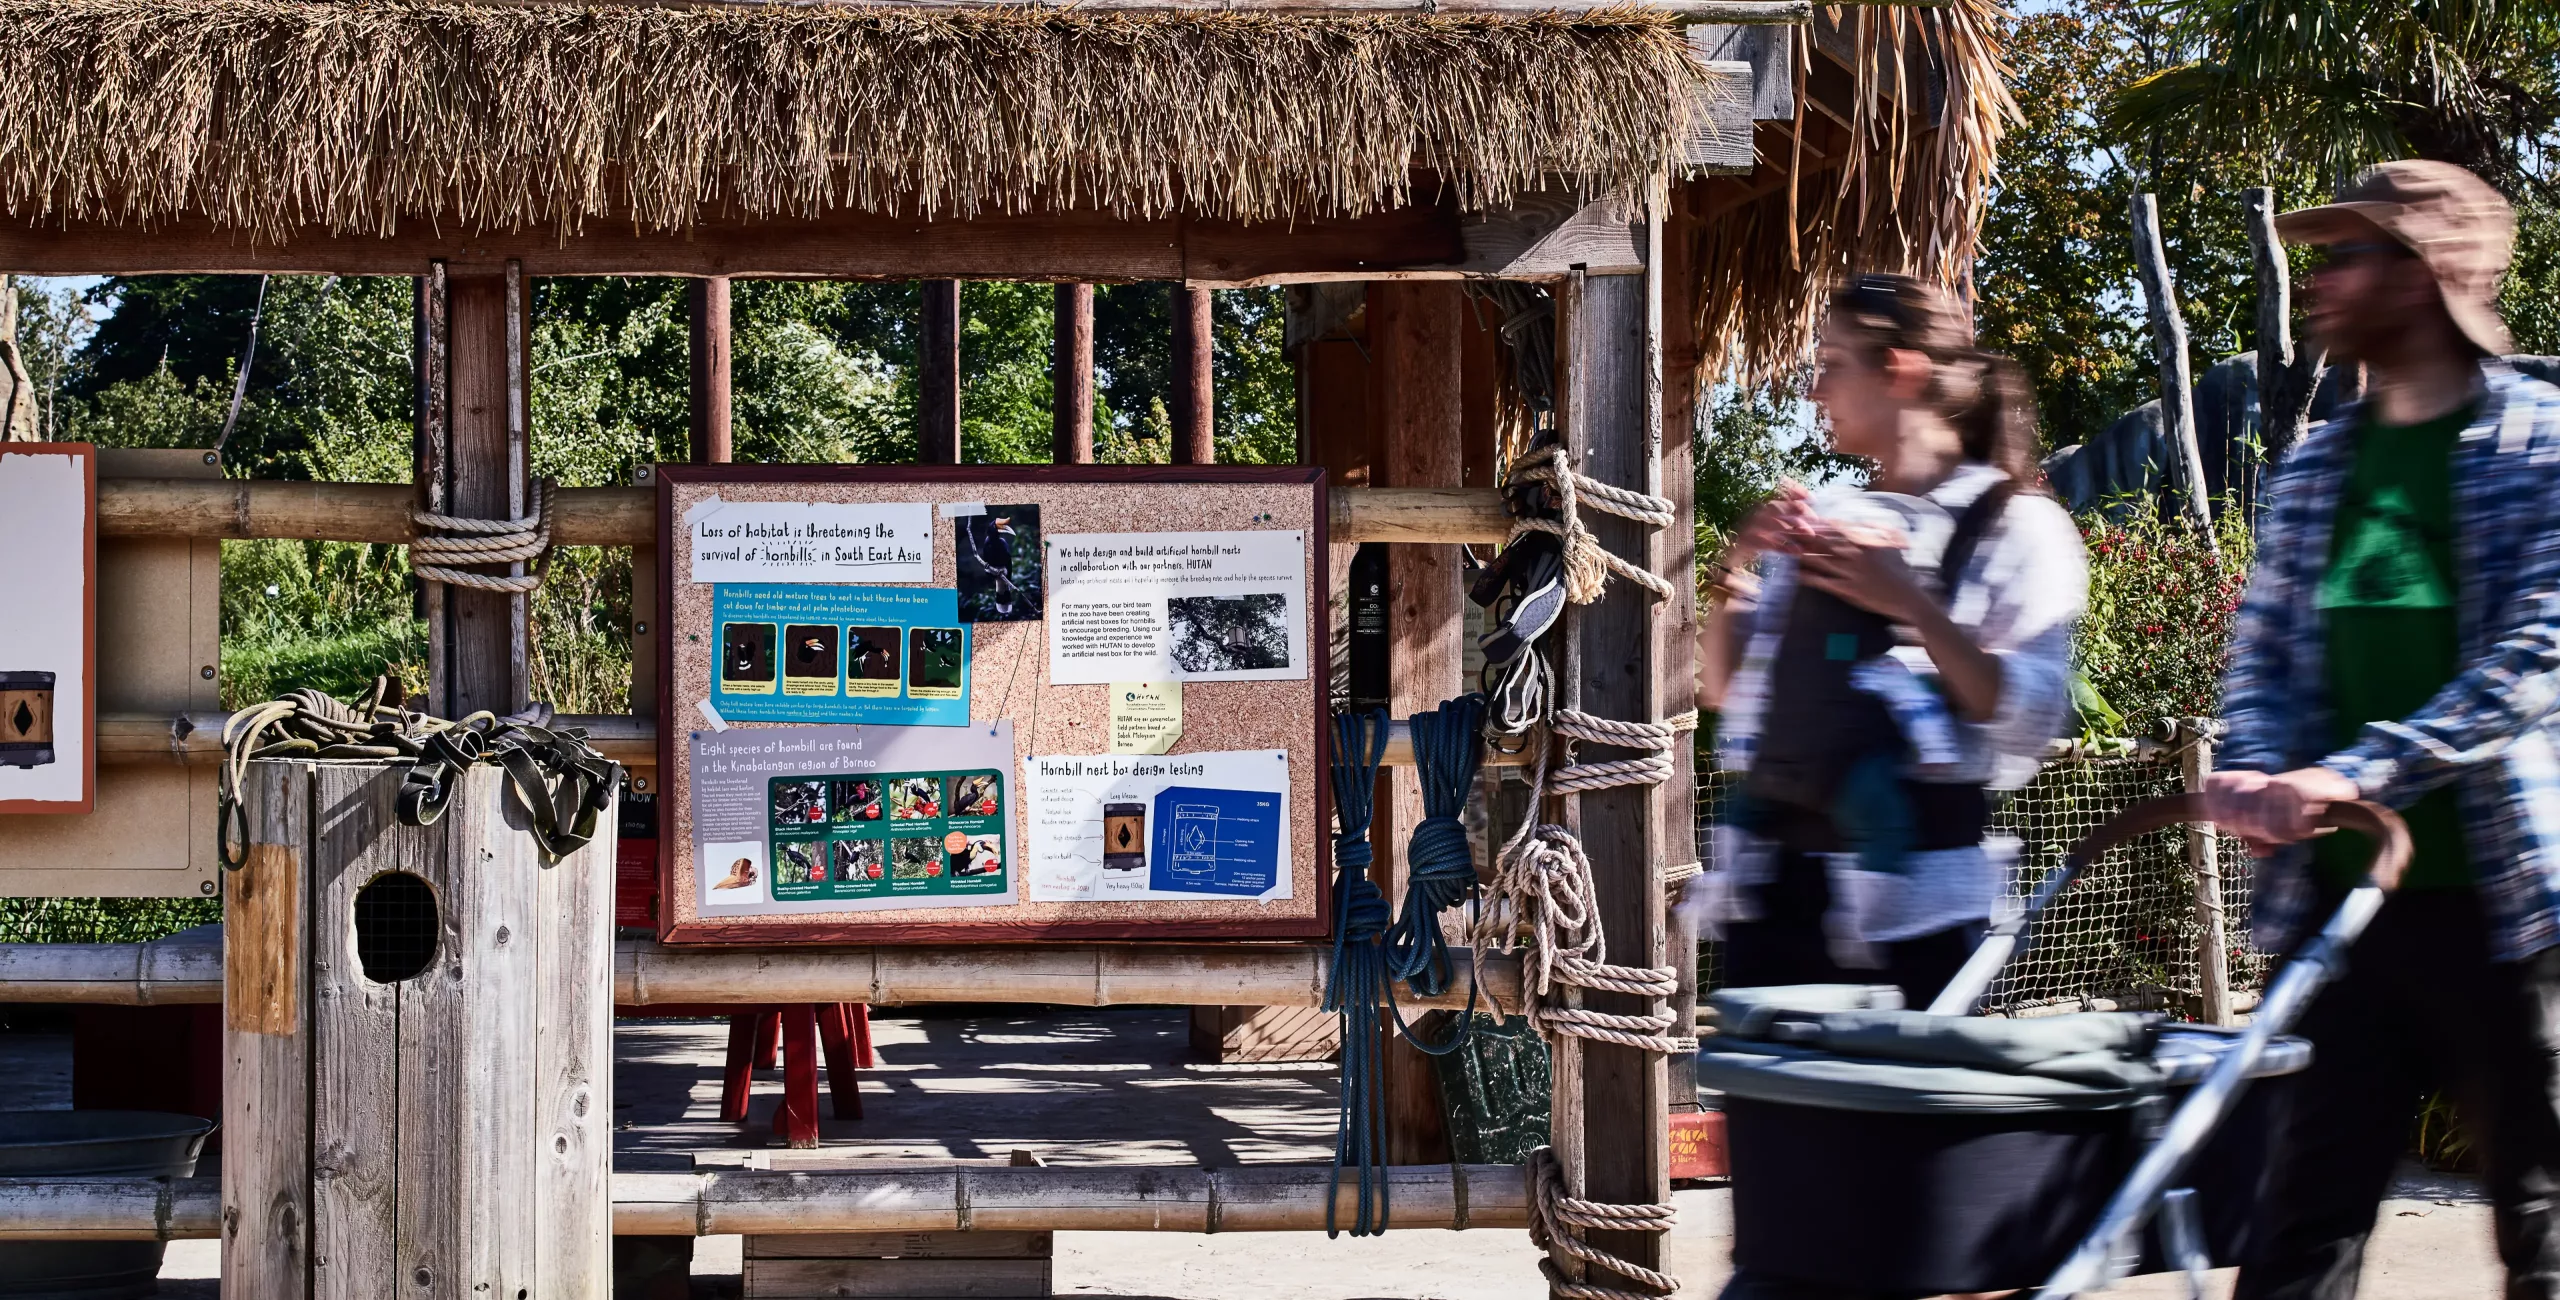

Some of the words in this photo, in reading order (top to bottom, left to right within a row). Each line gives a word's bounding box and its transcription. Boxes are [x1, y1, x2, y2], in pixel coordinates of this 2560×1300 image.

[701, 522, 723, 538] Loss
[728, 525, 742, 538] of
[746, 521, 790, 538] habitat
[794, 525, 802, 538] is
[807, 522, 871, 539] threatening
[876, 522, 894, 538] the
[701, 546, 740, 562] survival
[745, 548, 758, 562] of
[765, 546, 812, 562] hornbills
[821, 549, 830, 562] in
[835, 546, 863, 562] South
[868, 546, 893, 562] East
[898, 546, 921, 562] Asia
[1060, 548, 1072, 558] We
[1074, 547, 1090, 560] help
[1092, 546, 1117, 559] design
[1119, 546, 1133, 557] and
[1135, 545, 1154, 557] build
[1156, 545, 1188, 556] artificial
[1191, 545, 1219, 556] hornbill
[1222, 545, 1241, 555] nests
[1069, 561, 1120, 572] collaboration
[1122, 560, 1138, 571] with
[1186, 558, 1212, 570] HUTAN
[1062, 635, 1095, 643] knowledge
[700, 742, 726, 756] Eight
[729, 746, 761, 757] species
[764, 742, 776, 753] of
[779, 739, 816, 753] hornbill
[819, 743, 833, 752] are
[837, 738, 862, 750] found
[701, 765, 709, 774] in
[712, 759, 727, 773] the
[731, 758, 795, 772] Kinabatangan
[798, 760, 826, 770] region
[830, 757, 840, 769] of
[843, 756, 876, 768] Borneo
[1041, 761, 1082, 776] Hornbill
[1087, 762, 1109, 776] nest
[1113, 760, 1128, 776] box
[1132, 762, 1165, 776] design
[1170, 762, 1204, 776] testing
[630, 792, 652, 803] NOW
